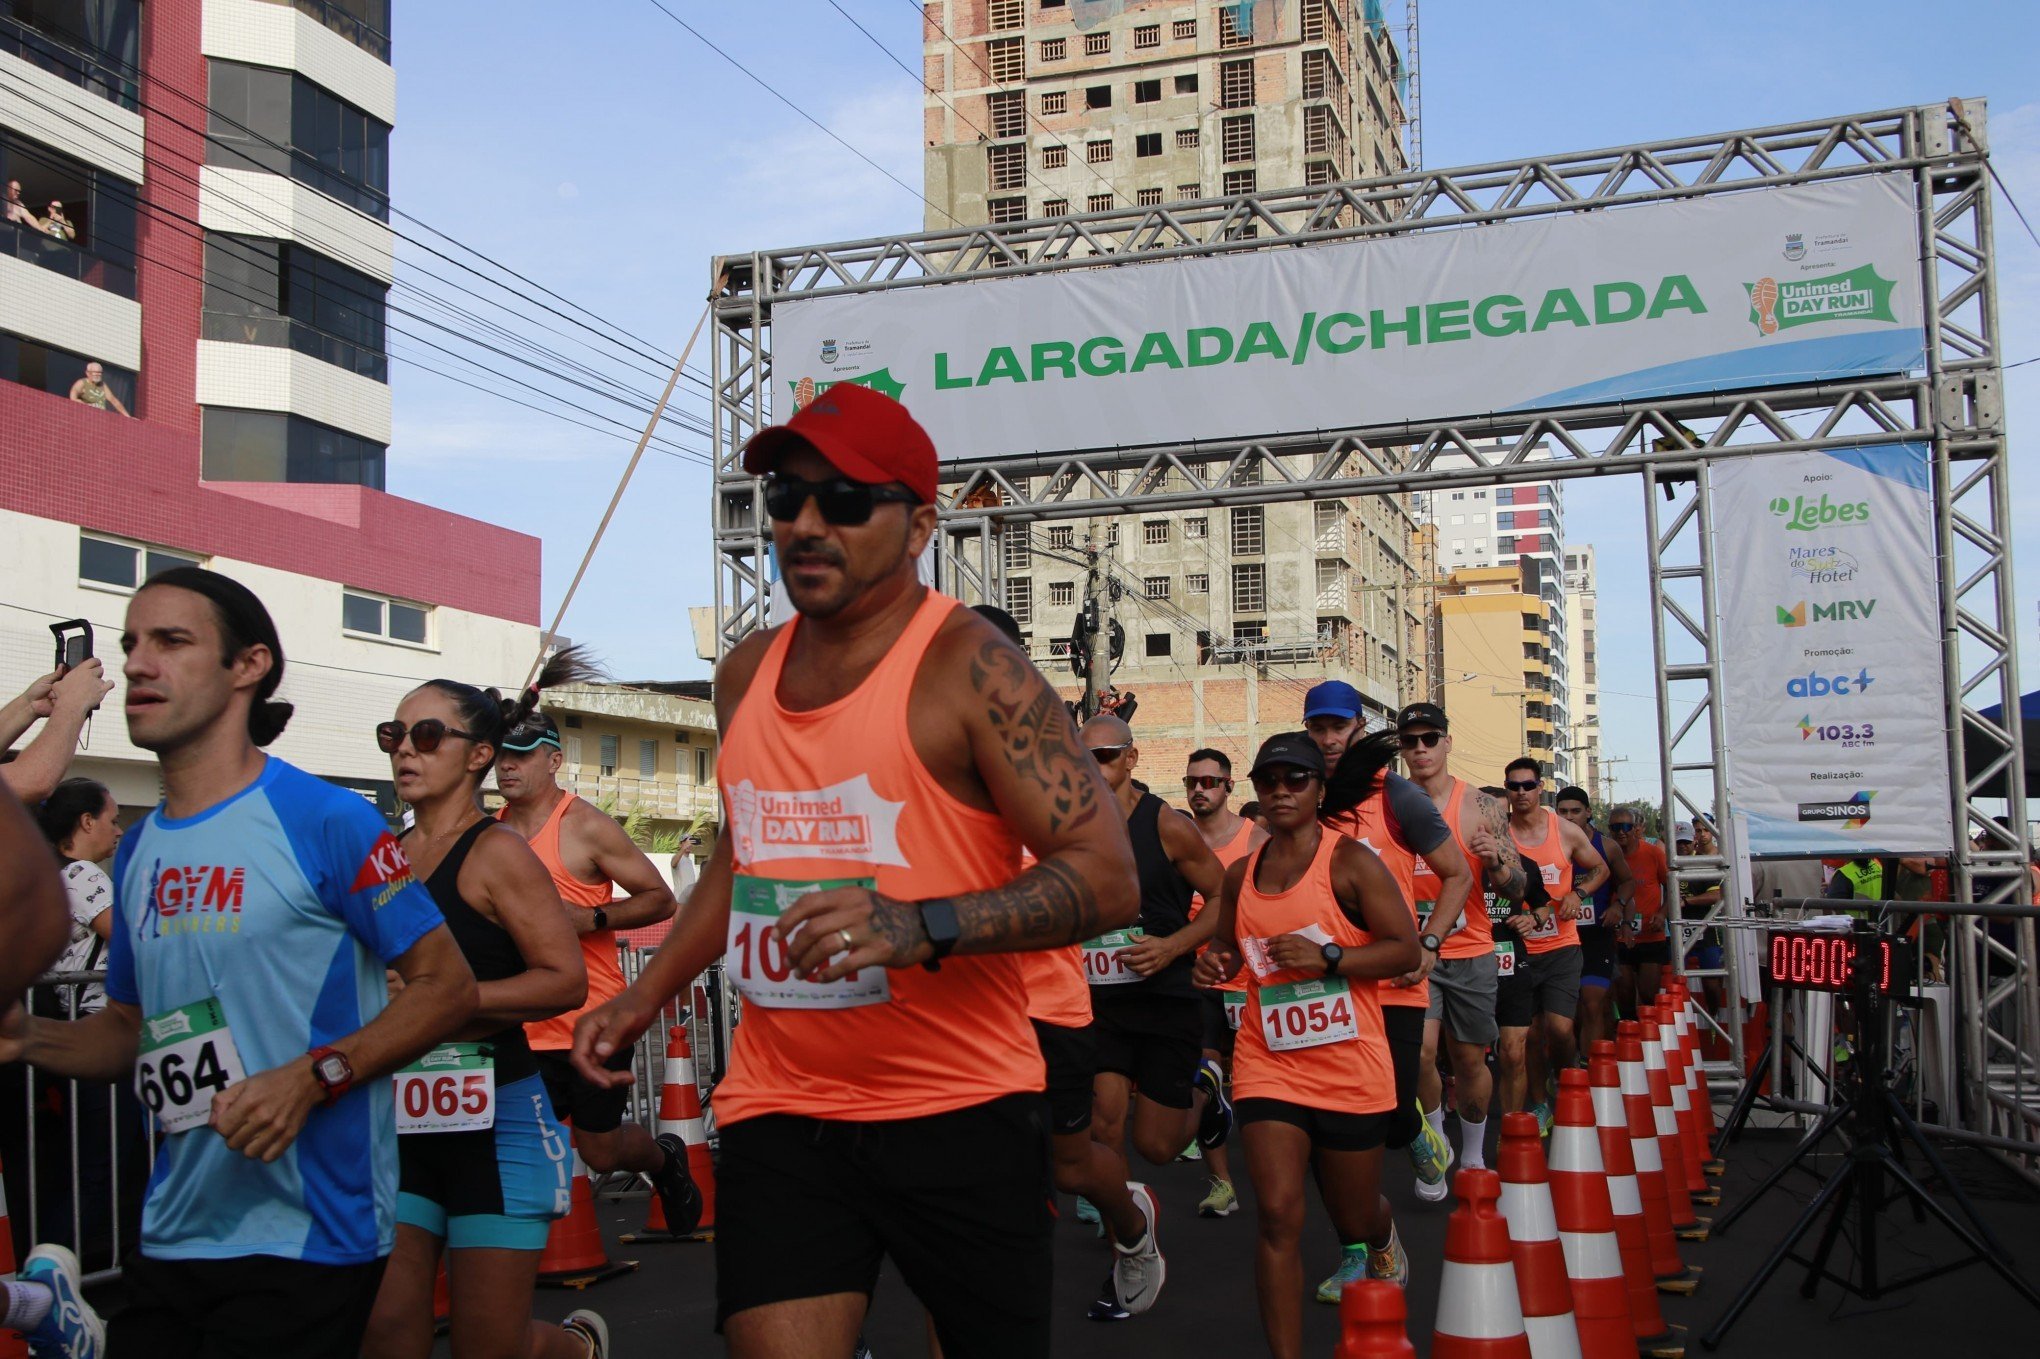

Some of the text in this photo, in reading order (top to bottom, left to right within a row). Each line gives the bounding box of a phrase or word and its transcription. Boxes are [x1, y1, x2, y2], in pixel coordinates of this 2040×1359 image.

[1782, 279, 1851, 298] Unimed
[1787, 293, 1865, 314] DAY RUN
[935, 274, 1707, 390] LARGADA/CHEGADA
[1803, 474, 1833, 483] Apoio:
[1785, 494, 1869, 531] Lebes
[1789, 546, 1836, 559] Mares
[1790, 560, 1804, 568] do
[1810, 569, 1852, 583] Hotel
[1813, 599, 1877, 622] MRV
[1804, 648, 1854, 657] Promoção:
[1816, 724, 1874, 741] 103.3
[1810, 771, 1864, 780] Realização:
[760, 797, 842, 814] Unimed
[1826, 805, 1866, 816] SINOS
[766, 820, 860, 841] DAY RUN
[157, 866, 244, 916] GYM
[1485, 907, 1511, 915] ASTRO
[1267, 997, 1352, 1038] 1054
[141, 1041, 229, 1113] 664
